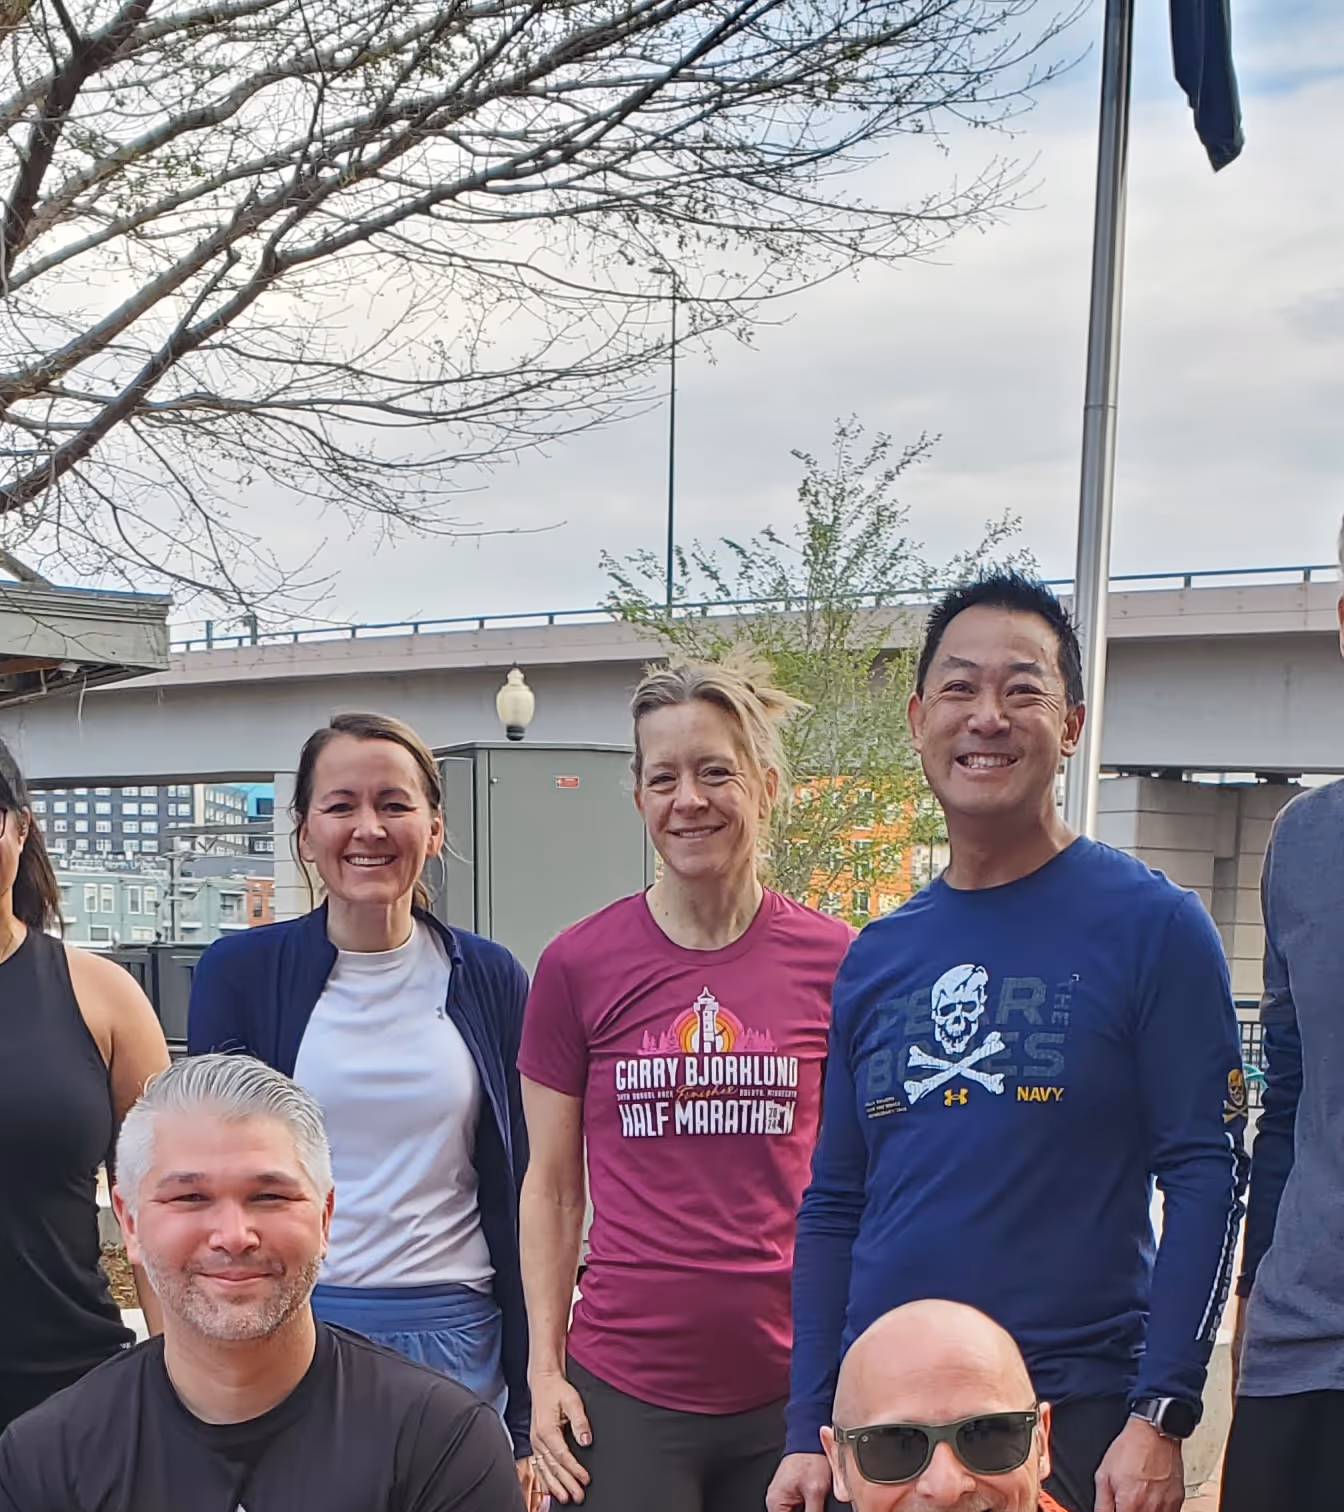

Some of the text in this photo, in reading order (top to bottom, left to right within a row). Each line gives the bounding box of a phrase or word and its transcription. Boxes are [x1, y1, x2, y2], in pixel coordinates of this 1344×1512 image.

[616, 1055, 799, 1091] GARRY BJORKLUND
[1017, 1086, 1064, 1102] NAVY
[619, 1102, 669, 1137] HALF
